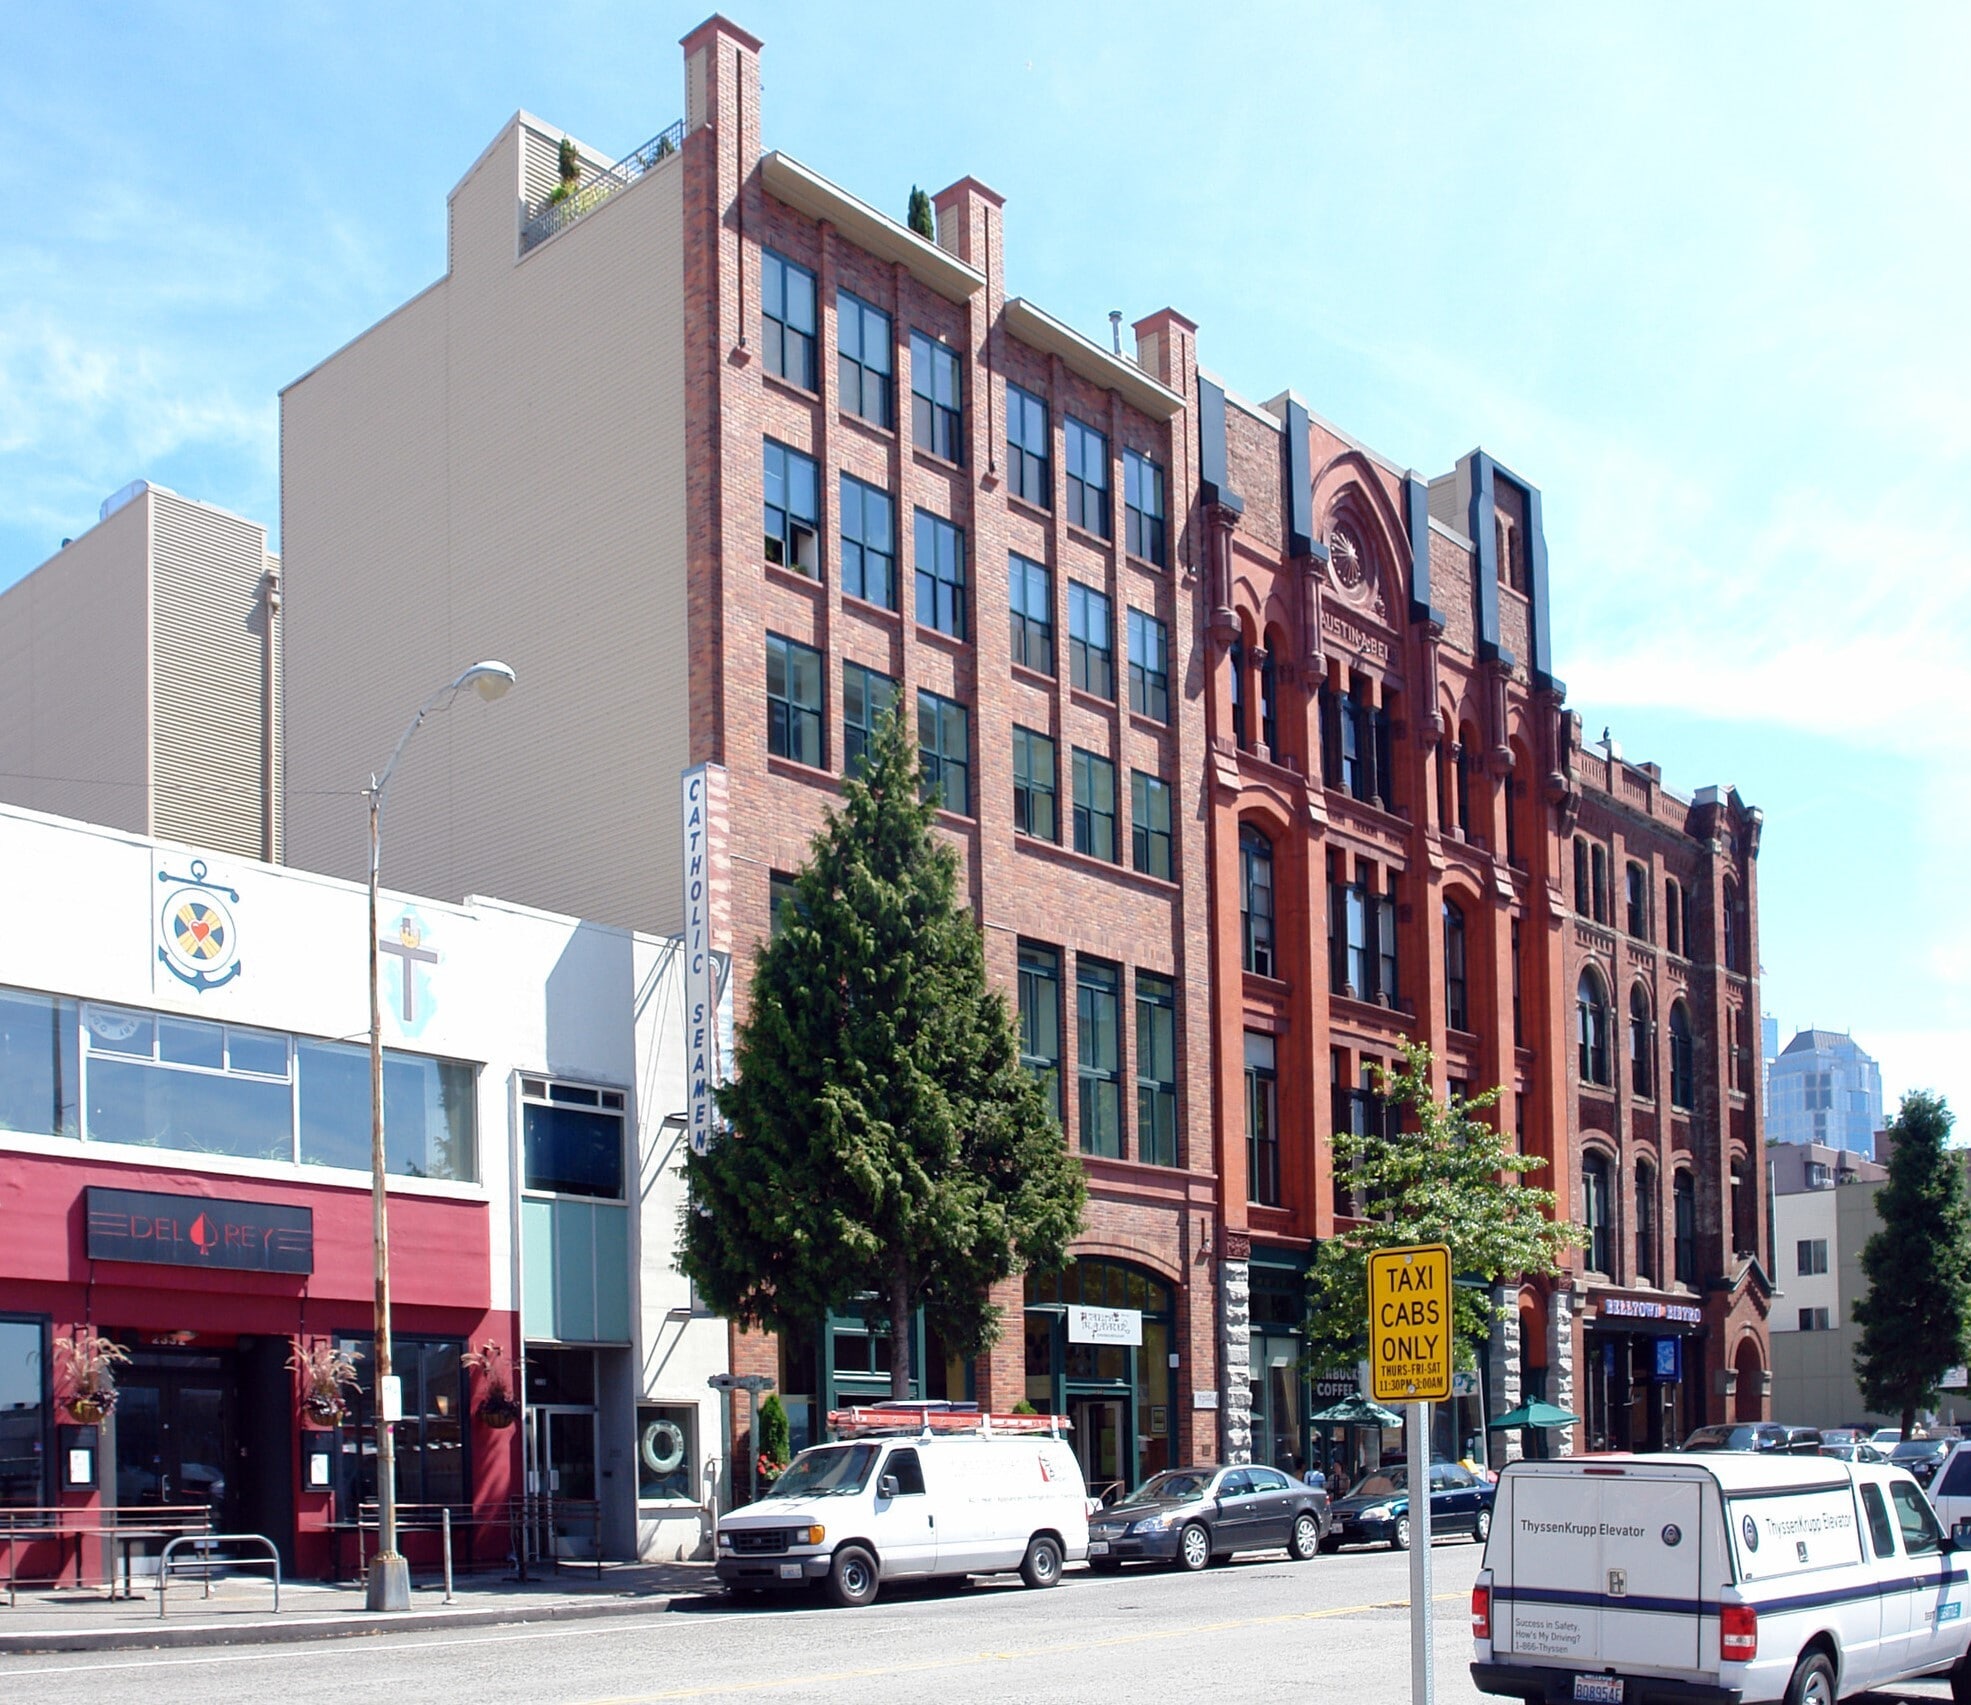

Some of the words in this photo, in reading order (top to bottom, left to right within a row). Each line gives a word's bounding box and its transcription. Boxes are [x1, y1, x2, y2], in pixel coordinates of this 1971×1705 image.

[1321, 610, 1360, 648] AUSTIN
[688, 779, 703, 975] CATHOLIC
[692, 1003, 707, 1150] SEAMEN
[130, 1214, 184, 1242] DEL
[224, 1222, 274, 1249] REY
[1386, 1265, 1433, 1293] TAXI
[1381, 1299, 1440, 1328] CABS
[1666, 1303, 1702, 1323] BISTRO
[1382, 1334, 1439, 1362] ONLY
[1381, 1362, 1441, 1377] THURS-FRI-SAT
[1316, 1382, 1354, 1397] COFFEE
[1521, 1519, 1597, 1538] ThyssenKrupp
[1599, 1523, 1646, 1538] Elevator
[1765, 1515, 1822, 1539] ThyssenKrupp
[1822, 1511, 1852, 1530] Elevator
[1515, 1618, 1545, 1629] Success
[1546, 1620, 1553, 1630] in
[1515, 1630, 1537, 1640] How's
[1538, 1632, 1549, 1642] My
[1551, 1633, 1581, 1645] Driving?
